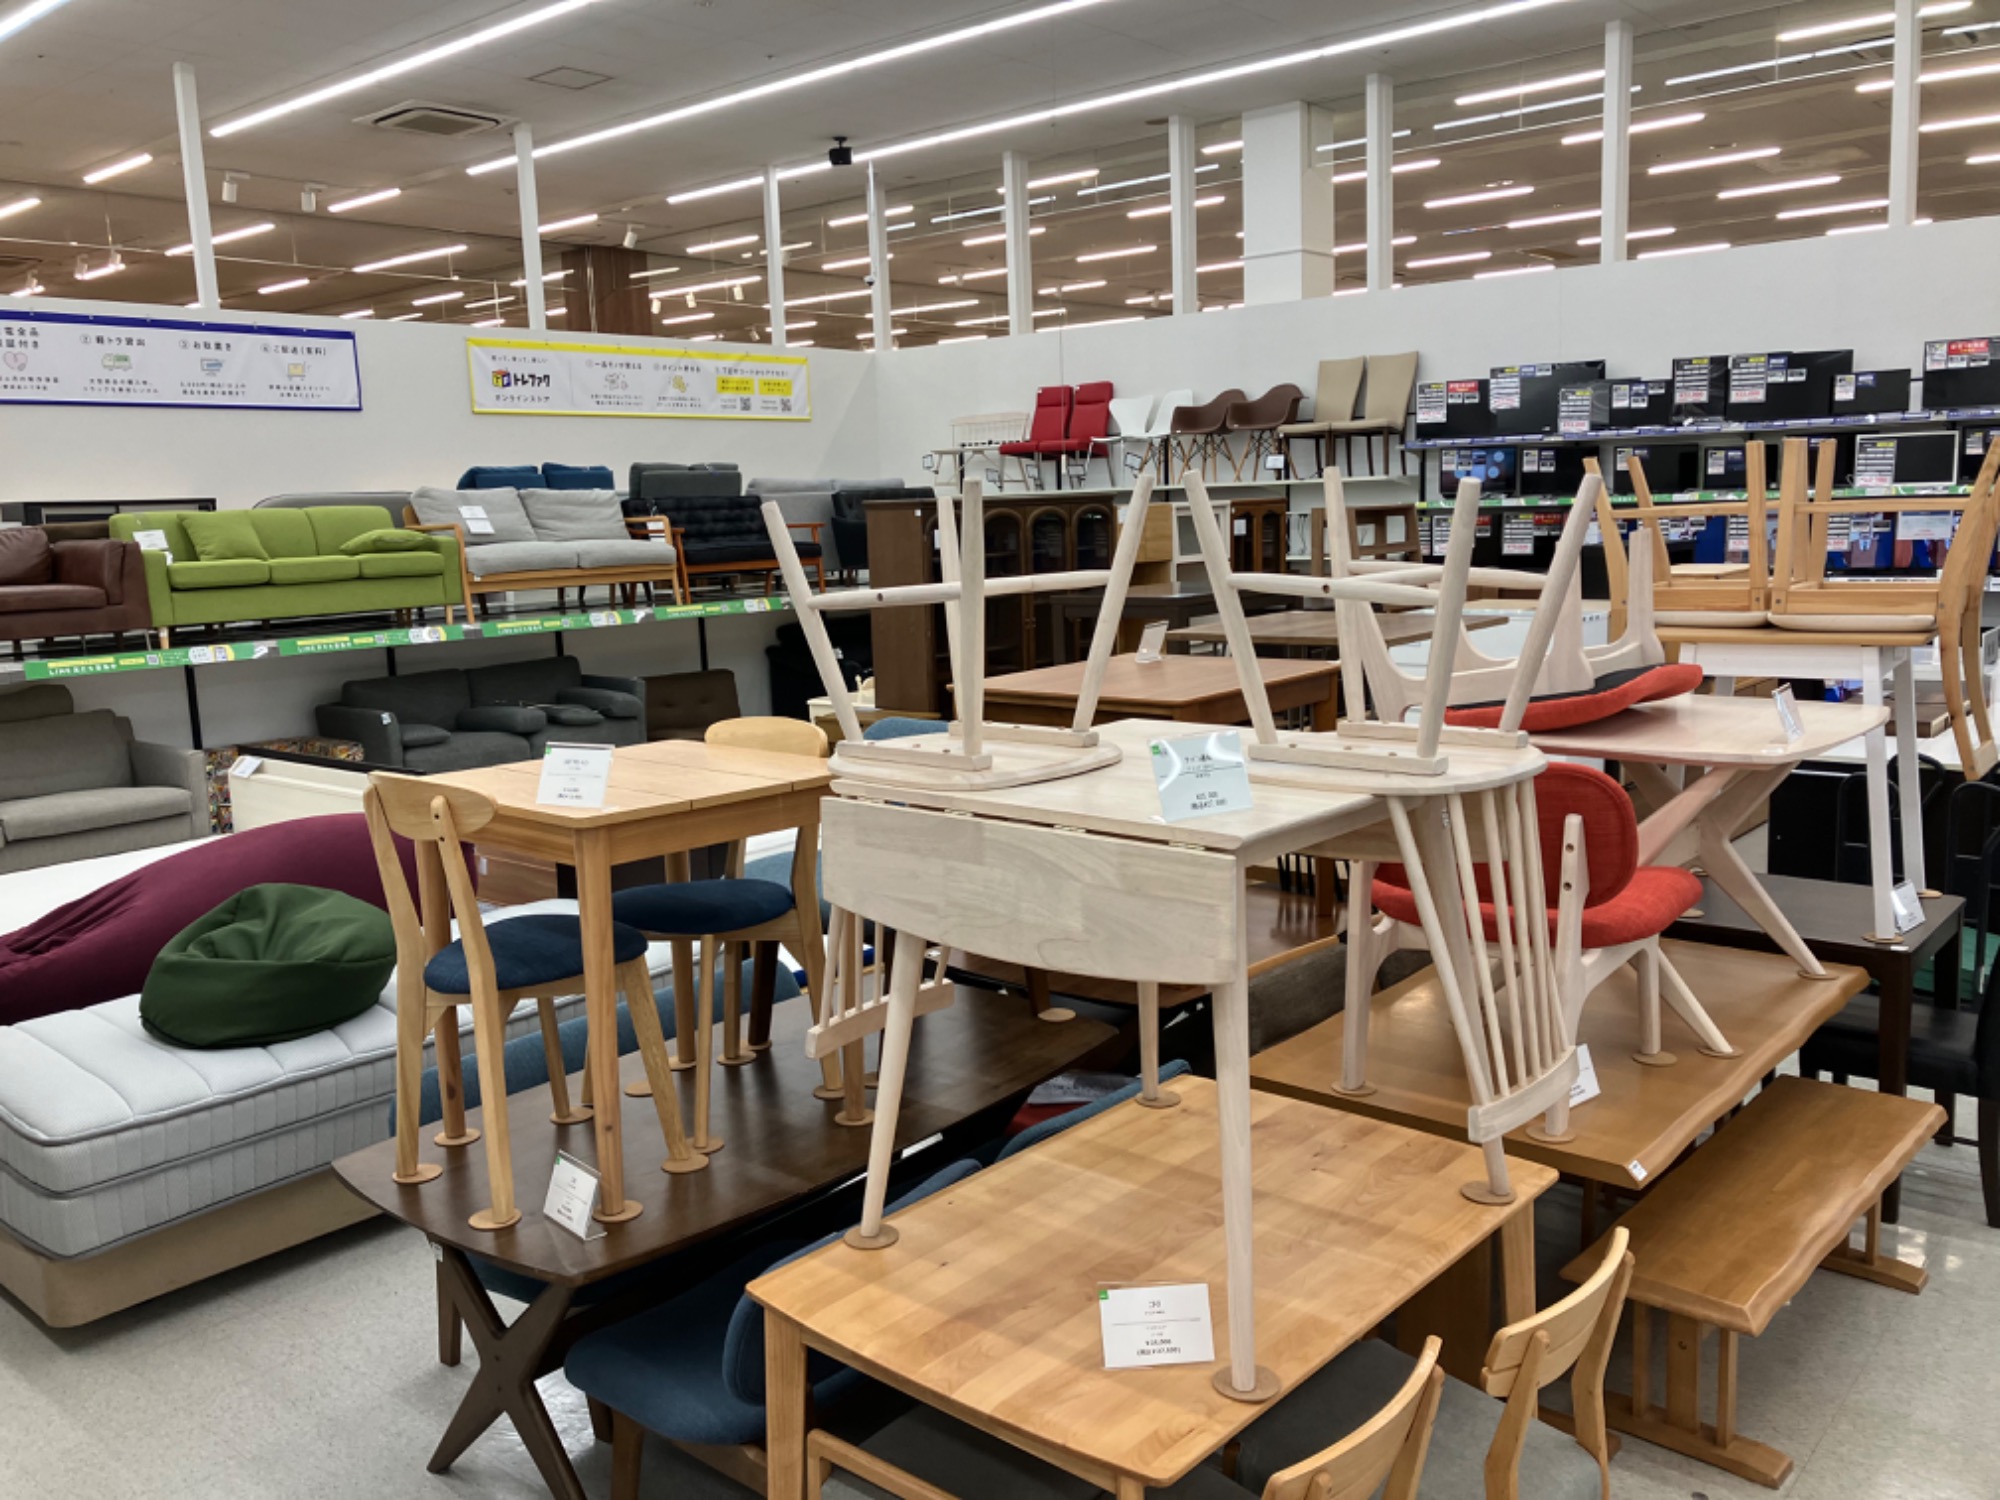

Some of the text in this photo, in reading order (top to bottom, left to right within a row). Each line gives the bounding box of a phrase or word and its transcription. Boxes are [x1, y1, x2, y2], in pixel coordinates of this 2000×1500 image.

[513, 372, 551, 388] トレファク
[495, 393, 551, 403] オンラインストア
